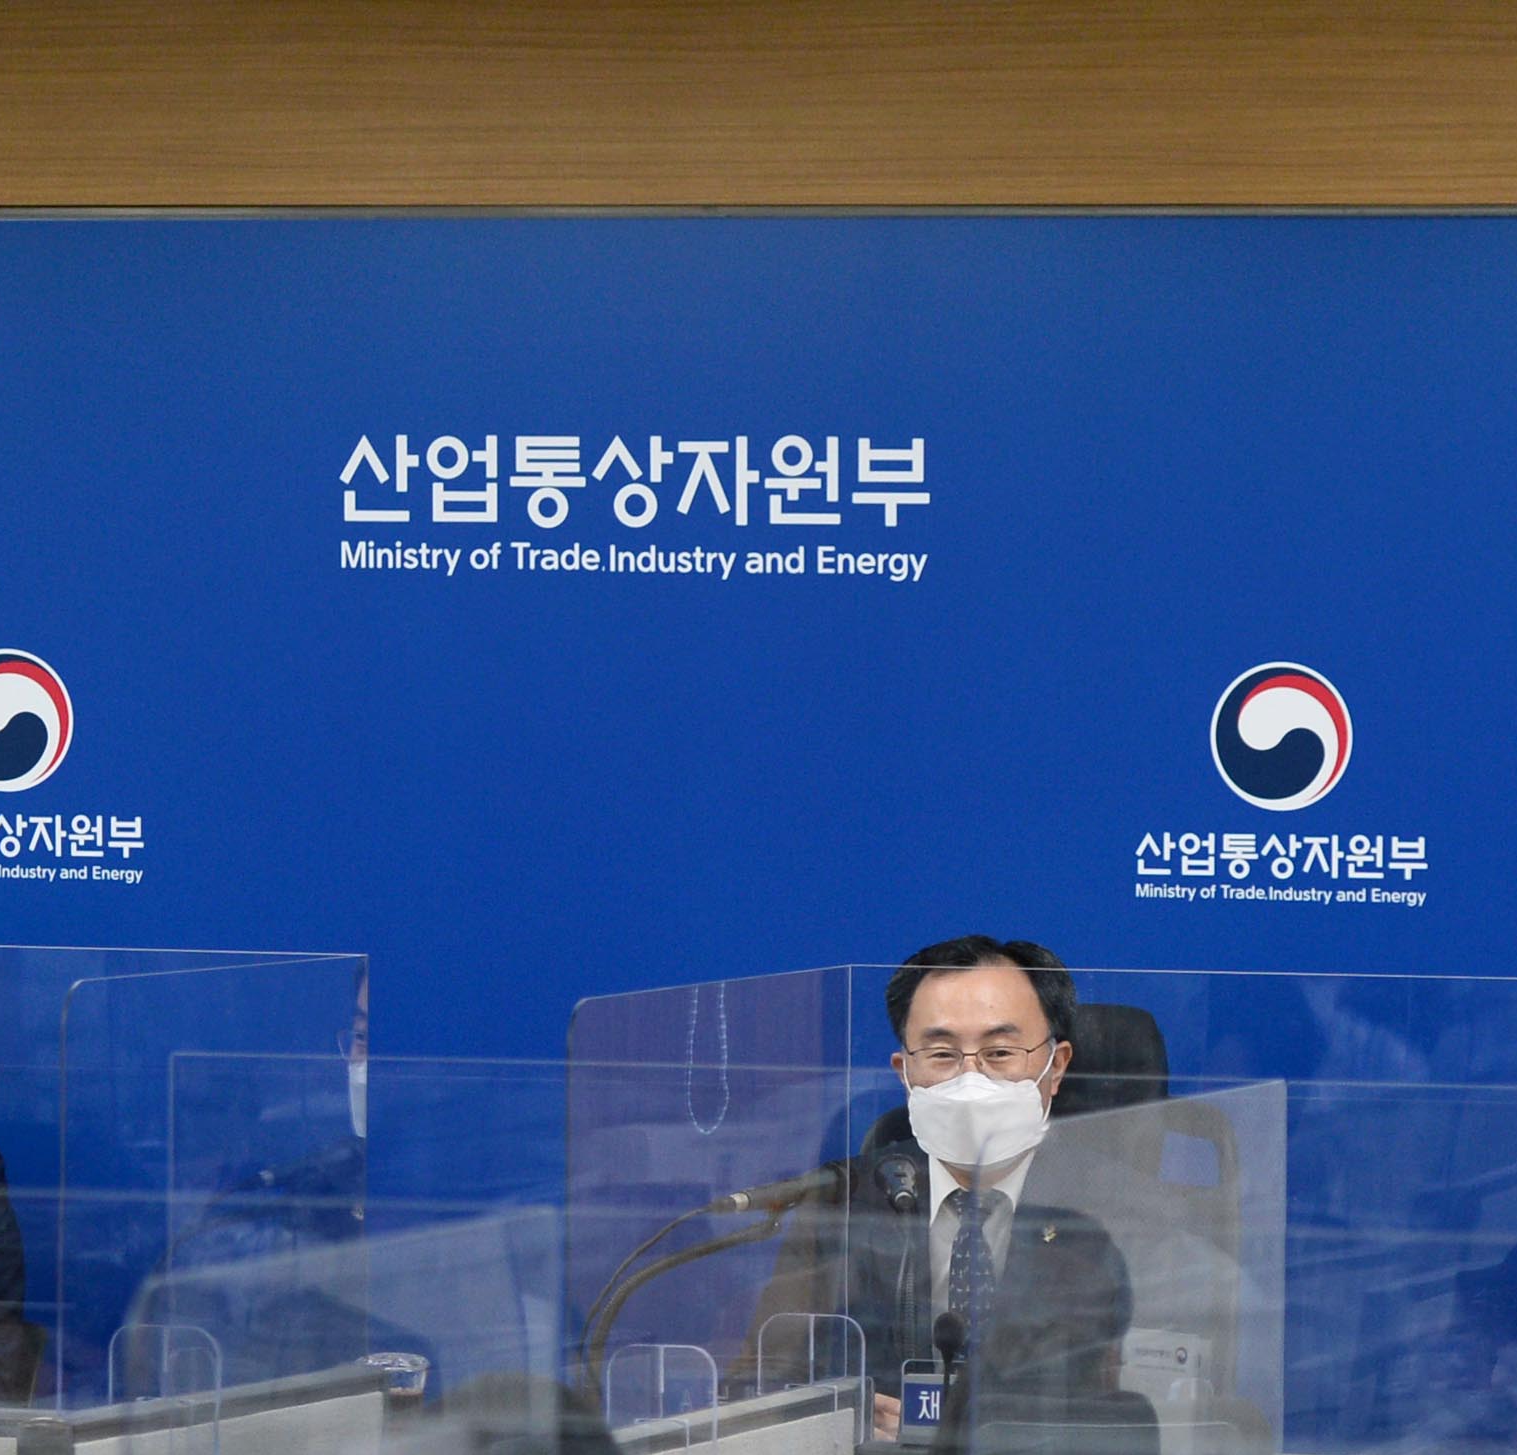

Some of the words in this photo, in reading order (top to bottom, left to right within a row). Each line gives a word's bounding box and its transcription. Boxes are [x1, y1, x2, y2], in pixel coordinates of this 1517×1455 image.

[339, 433, 931, 529] 산업통상자원부
[340, 540, 462, 577] Ministry
[469, 541, 502, 570] of
[744, 545, 805, 575] and
[816, 545, 928, 582] Energy
[1135, 831, 1429, 881] 산업통상자원부
[59, 865, 88, 880] and
[91, 865, 144, 884] Energy
[1135, 882, 1197, 902] Ministry
[1199, 884, 1217, 900] of
[1335, 887, 1367, 903] and
[1370, 887, 1427, 907] Energy
[918, 1390, 941, 1420] 채
